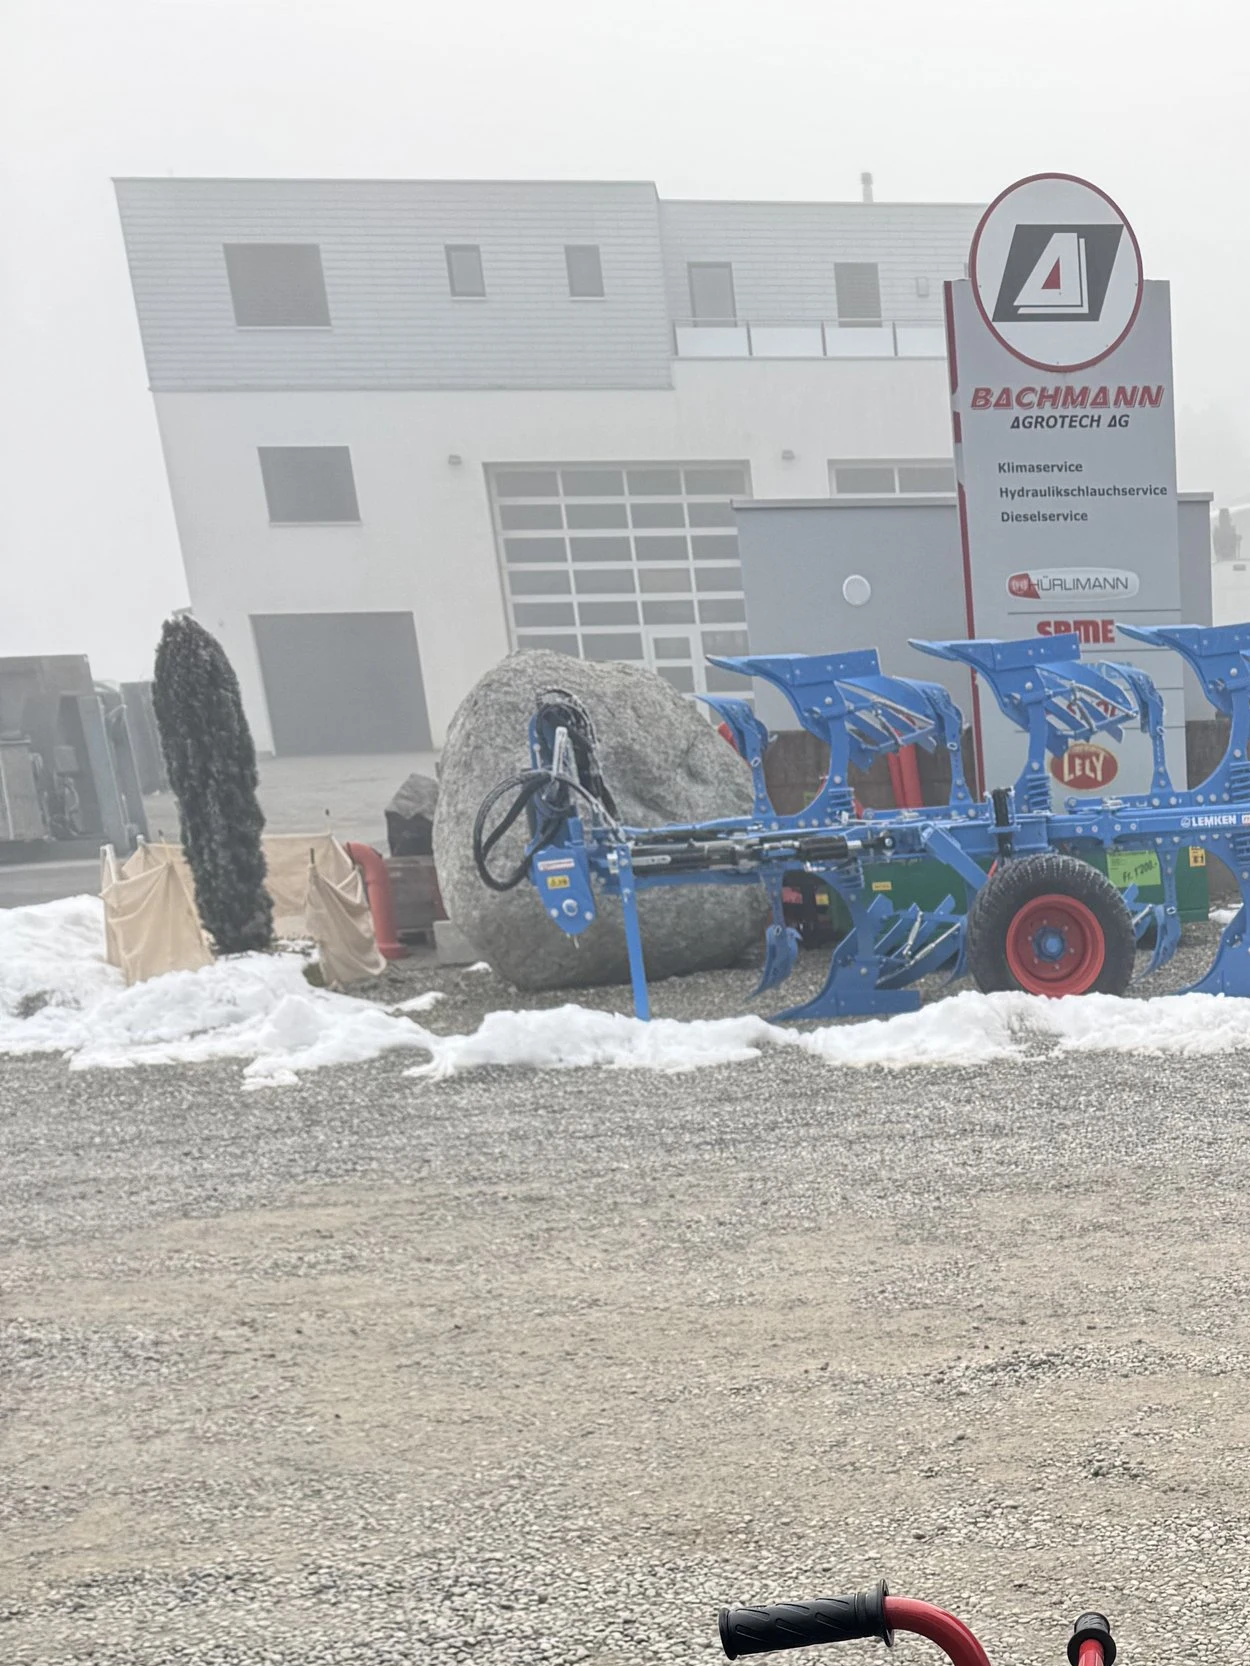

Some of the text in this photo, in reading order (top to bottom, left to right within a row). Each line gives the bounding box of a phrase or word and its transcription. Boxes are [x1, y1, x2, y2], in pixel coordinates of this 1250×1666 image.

[970, 384, 1165, 410] BACHMANN
[1010, 414, 1130, 430] AGROTECH AG
[998, 461, 1083, 474] Klimaservice
[999, 484, 1168, 499] Hydraulikschlauchservice
[1001, 511, 1088, 523] Dieselservice
[1028, 575, 1129, 591] HÜRLIMANN
[1063, 750, 1105, 782] LELY
[1191, 814, 1237, 827] LEMKEN
